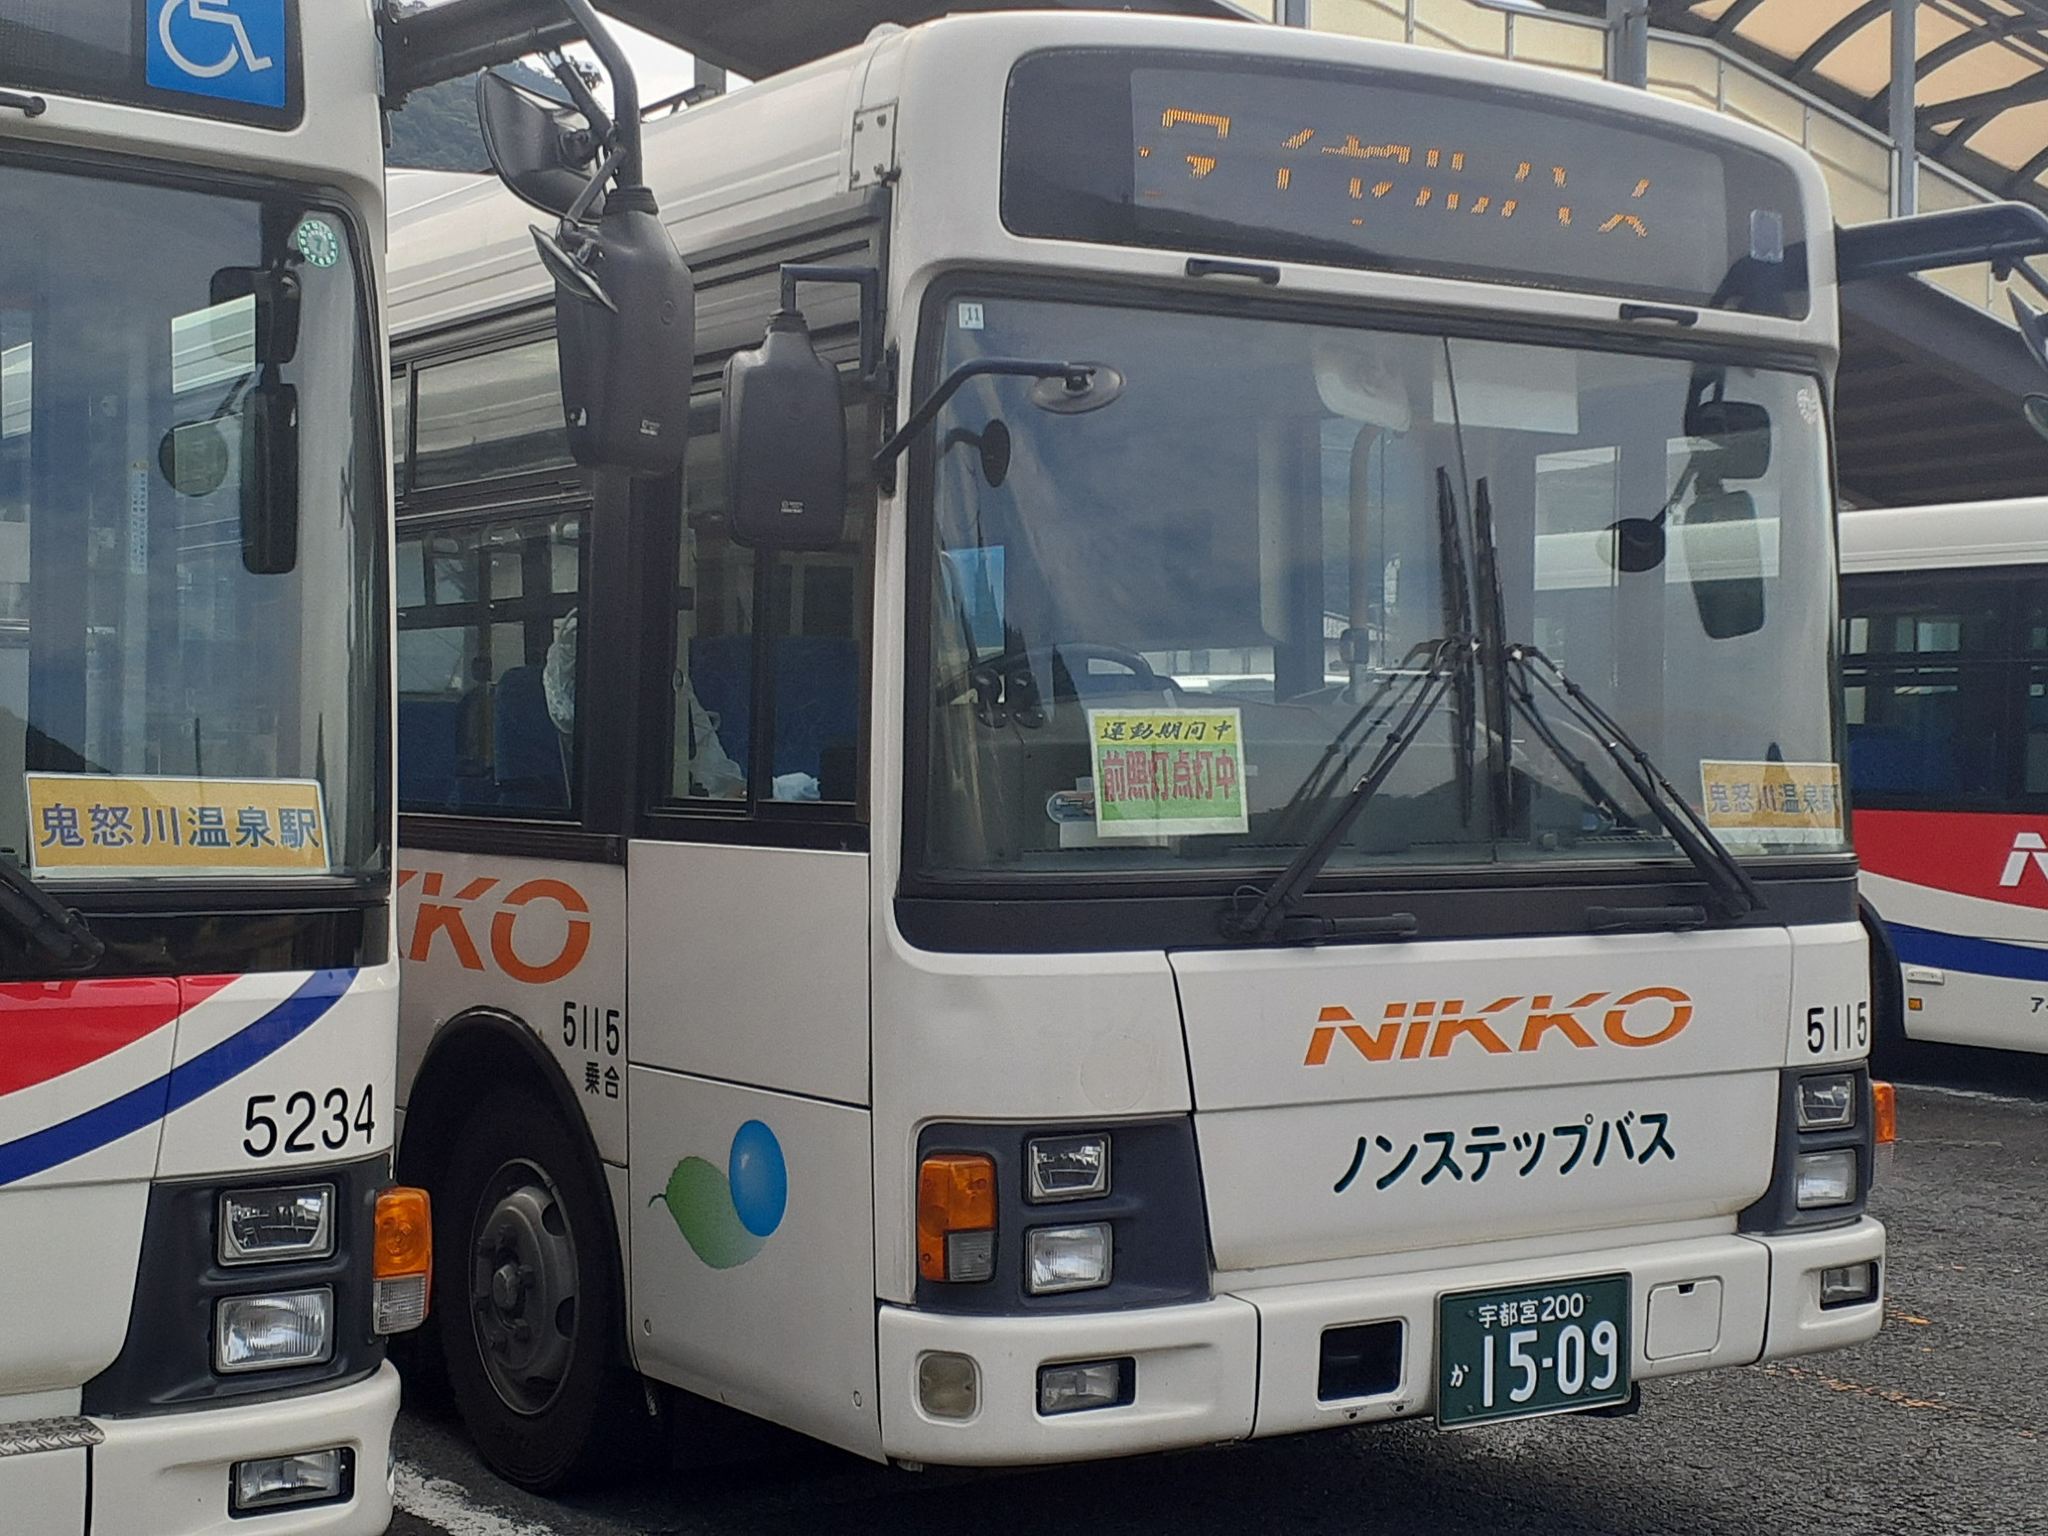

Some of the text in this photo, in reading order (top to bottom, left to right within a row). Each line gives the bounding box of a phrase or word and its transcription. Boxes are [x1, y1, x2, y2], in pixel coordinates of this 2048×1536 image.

[1100, 719, 1233, 742] 運動期間中
[1103, 749, 1236, 802] 前照灯点灯中
[40, 803, 320, 850] 鬼怒川温泉駅
[563, 1001, 621, 1056] 5115
[1806, 1000, 1868, 1055] 5115
[584, 1061, 620, 1100] 乗合
[243, 1083, 375, 1158] 5234
[1334, 1111, 1676, 1194] ノンステップバス
[1450, 1320, 1618, 1408] か 15-09
